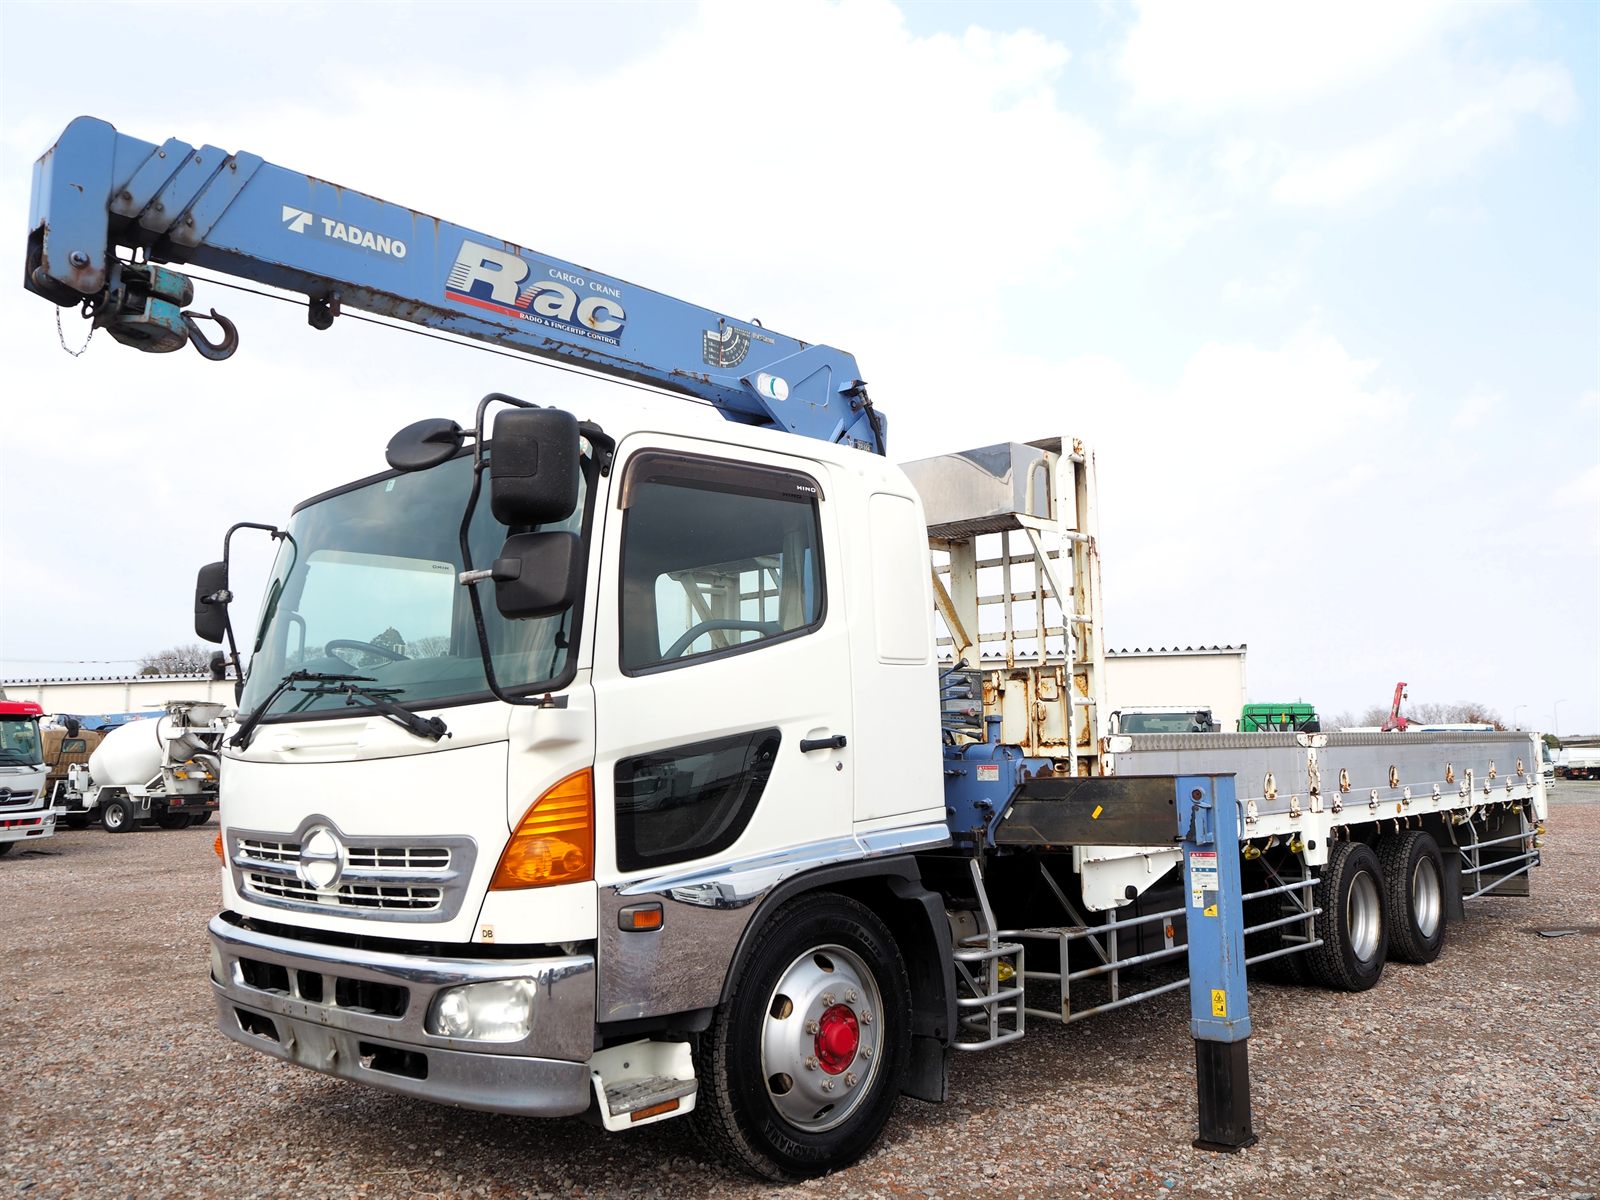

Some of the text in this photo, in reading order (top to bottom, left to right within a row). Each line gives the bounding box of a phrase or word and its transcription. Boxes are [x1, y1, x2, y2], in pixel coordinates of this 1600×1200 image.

[321, 217, 407, 259] TADANO
[446, 239, 625, 333] Rac
[549, 268, 622, 299] CARGO CRANE
[519, 312, 543, 326] RADIO
[550, 322, 586, 336] FINGERTIP
[586, 330, 619, 345] CONTROL
[796, 485, 817, 493] HINO
[482, 929, 493, 938] DB
